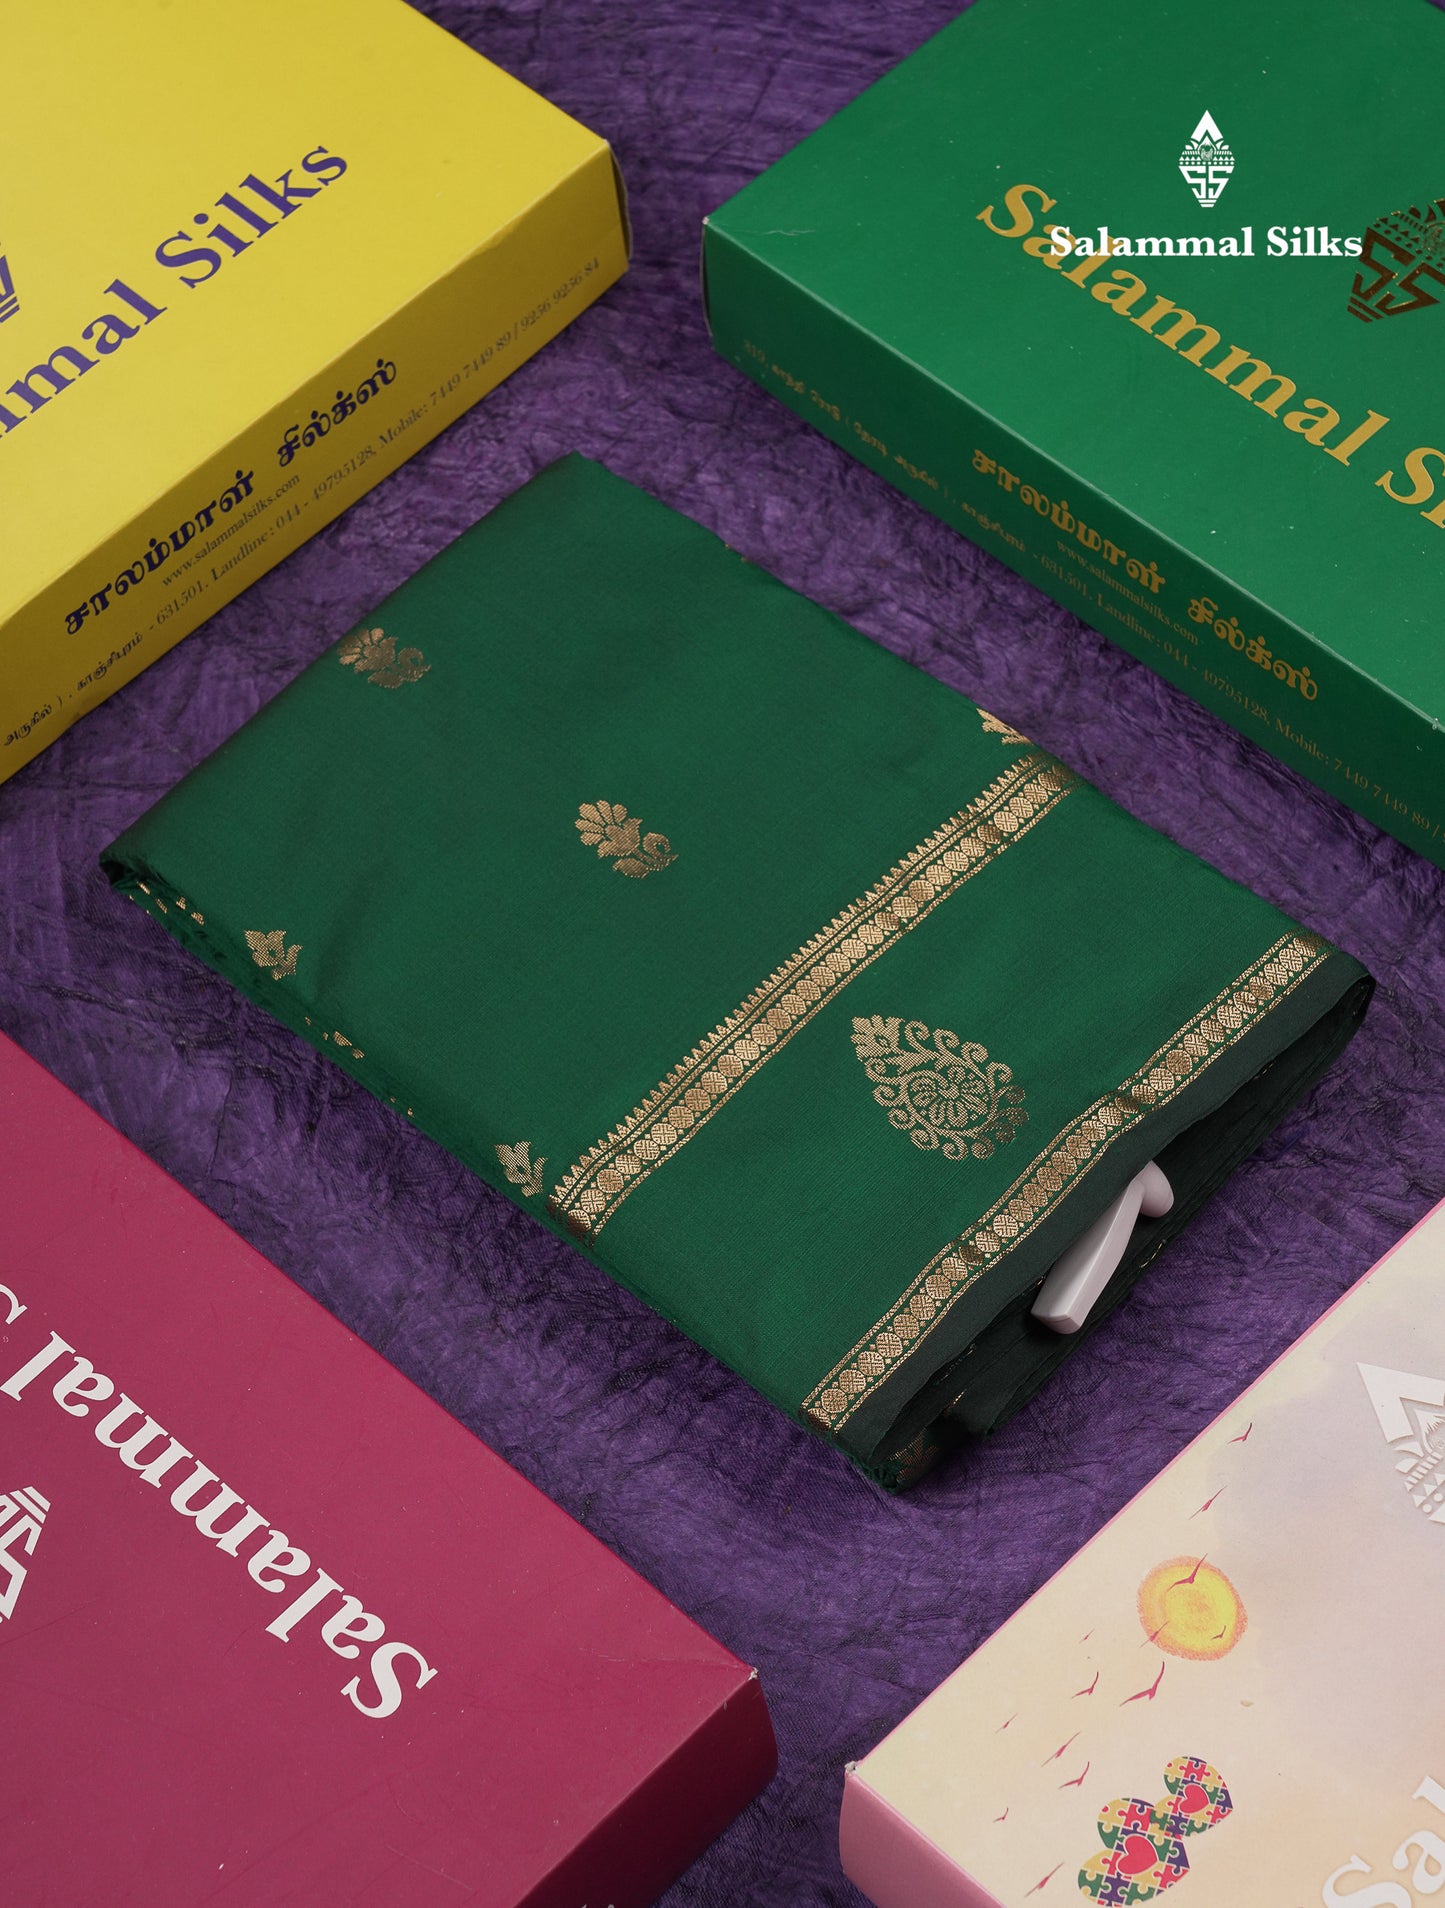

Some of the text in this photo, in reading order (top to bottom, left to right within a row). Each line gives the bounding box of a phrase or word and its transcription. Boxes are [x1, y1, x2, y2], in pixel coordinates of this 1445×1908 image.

[154, 144, 349, 289] Silks
[976, 184, 1390, 467] Salammal
[161, 473, 301, 587] www.salammalsilks.com
[1056, 540, 1199, 646] www.salammalsilks.com
[0, 1330, 439, 1719] Salammal
